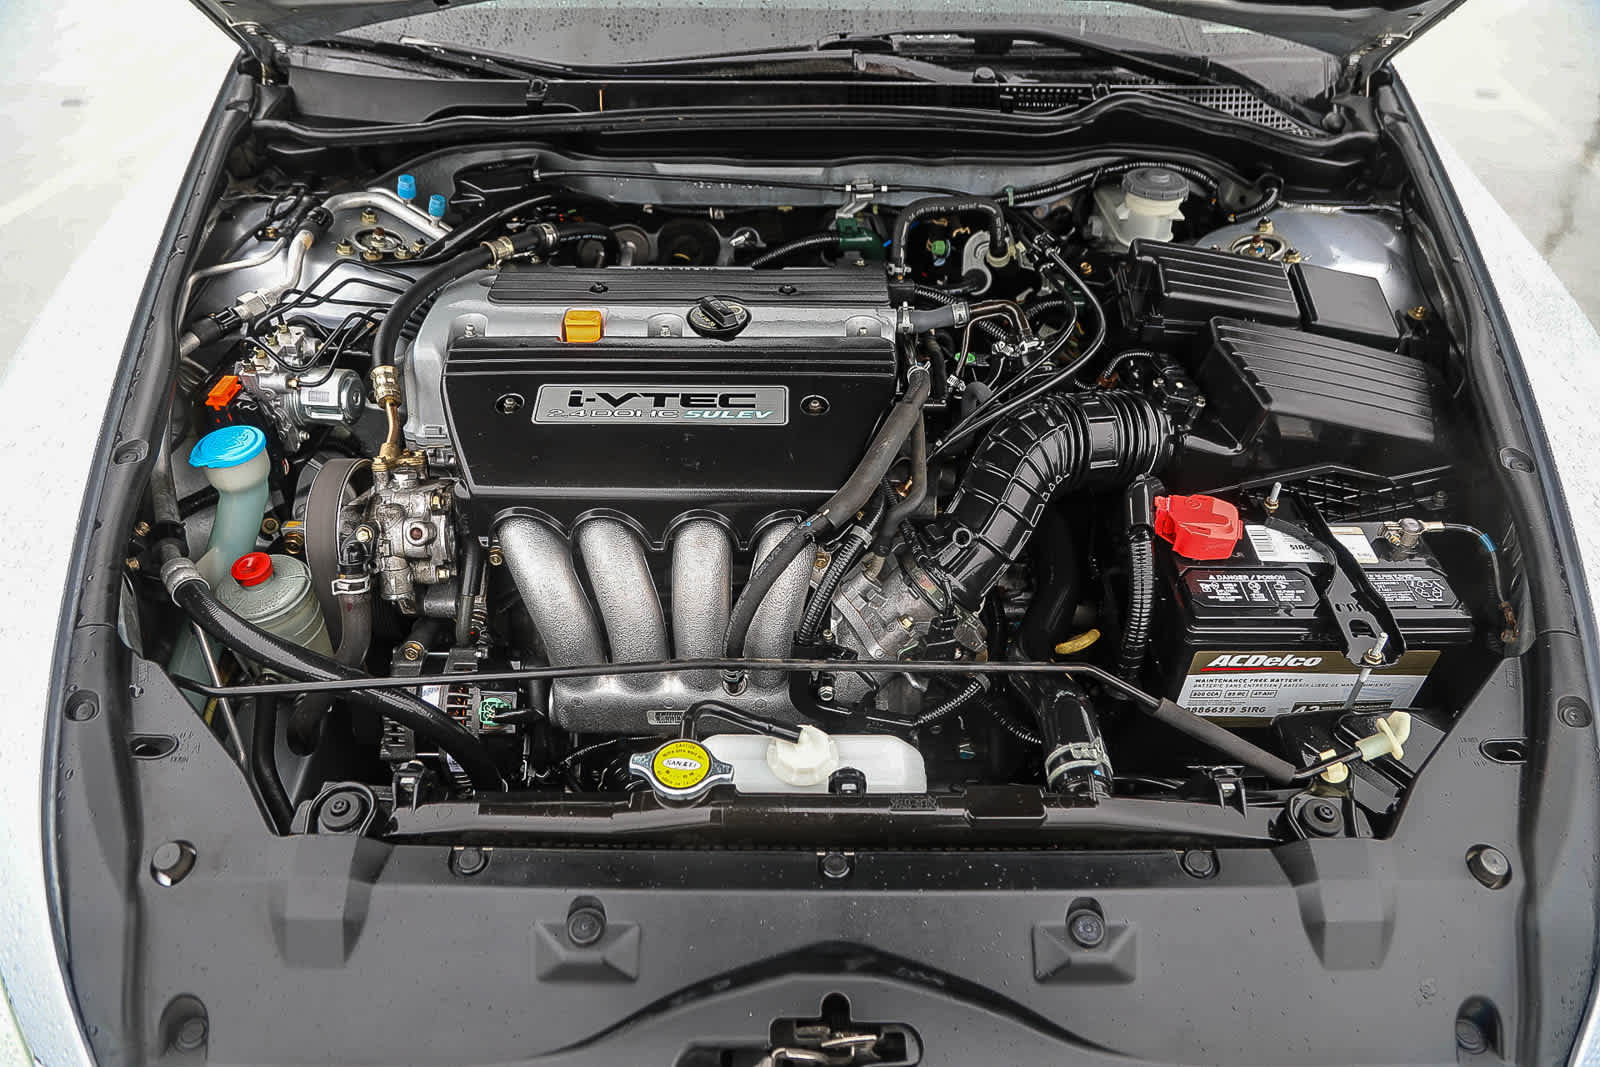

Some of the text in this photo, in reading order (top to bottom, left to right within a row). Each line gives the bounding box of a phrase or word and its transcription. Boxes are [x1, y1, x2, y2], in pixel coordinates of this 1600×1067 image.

[568, 390, 757, 409] i-VTEC
[683, 410, 774, 419] SULEV
[1207, 654, 1323, 667] ACDelco
